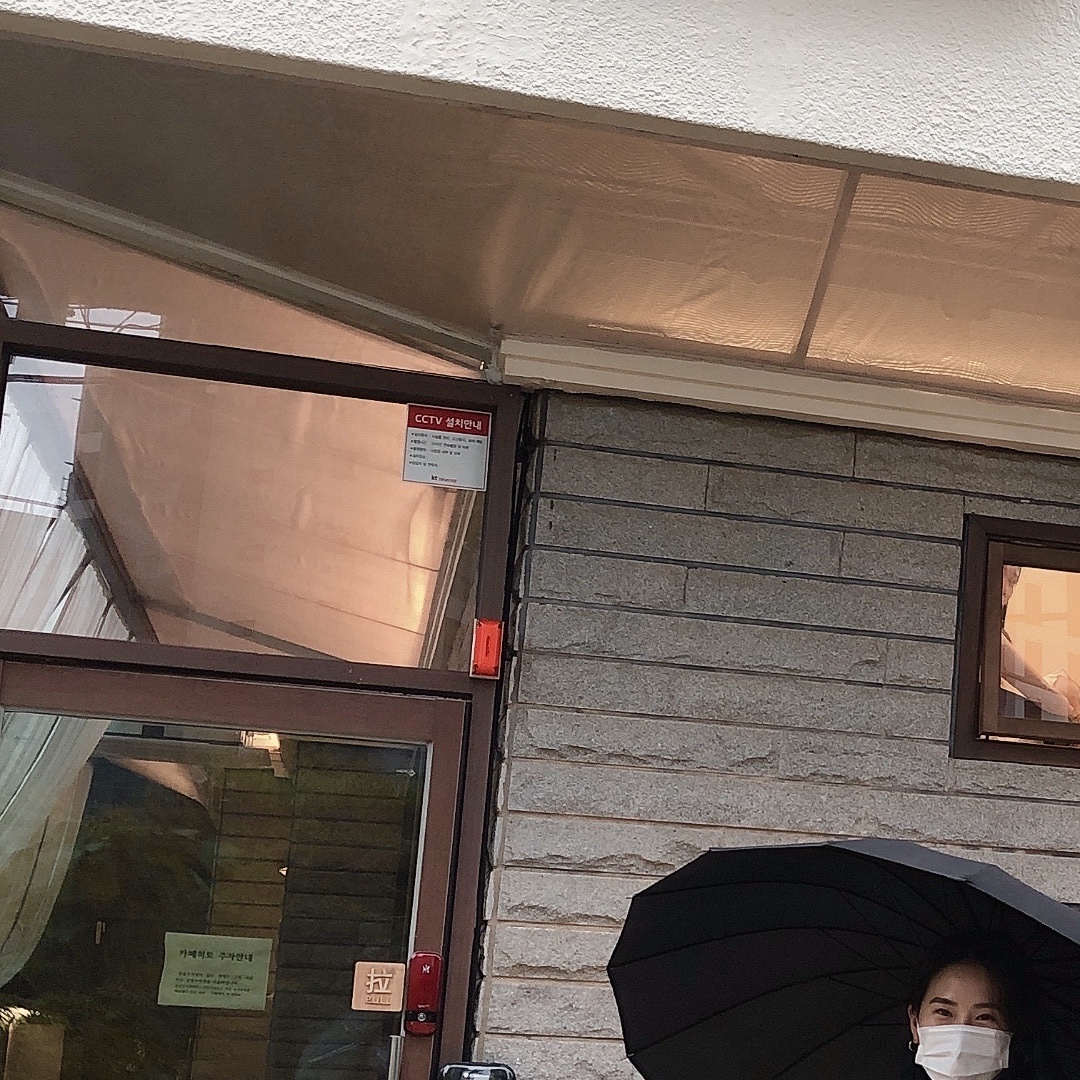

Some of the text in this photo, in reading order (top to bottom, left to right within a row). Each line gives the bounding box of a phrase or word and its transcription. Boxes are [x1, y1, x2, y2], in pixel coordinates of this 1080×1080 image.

[415, 414, 482, 431] CCTV 설치안내
[218, 951, 254, 963] 주차안내
[366, 967, 393, 994] 拉
[365, 995, 392, 1006] PULL
